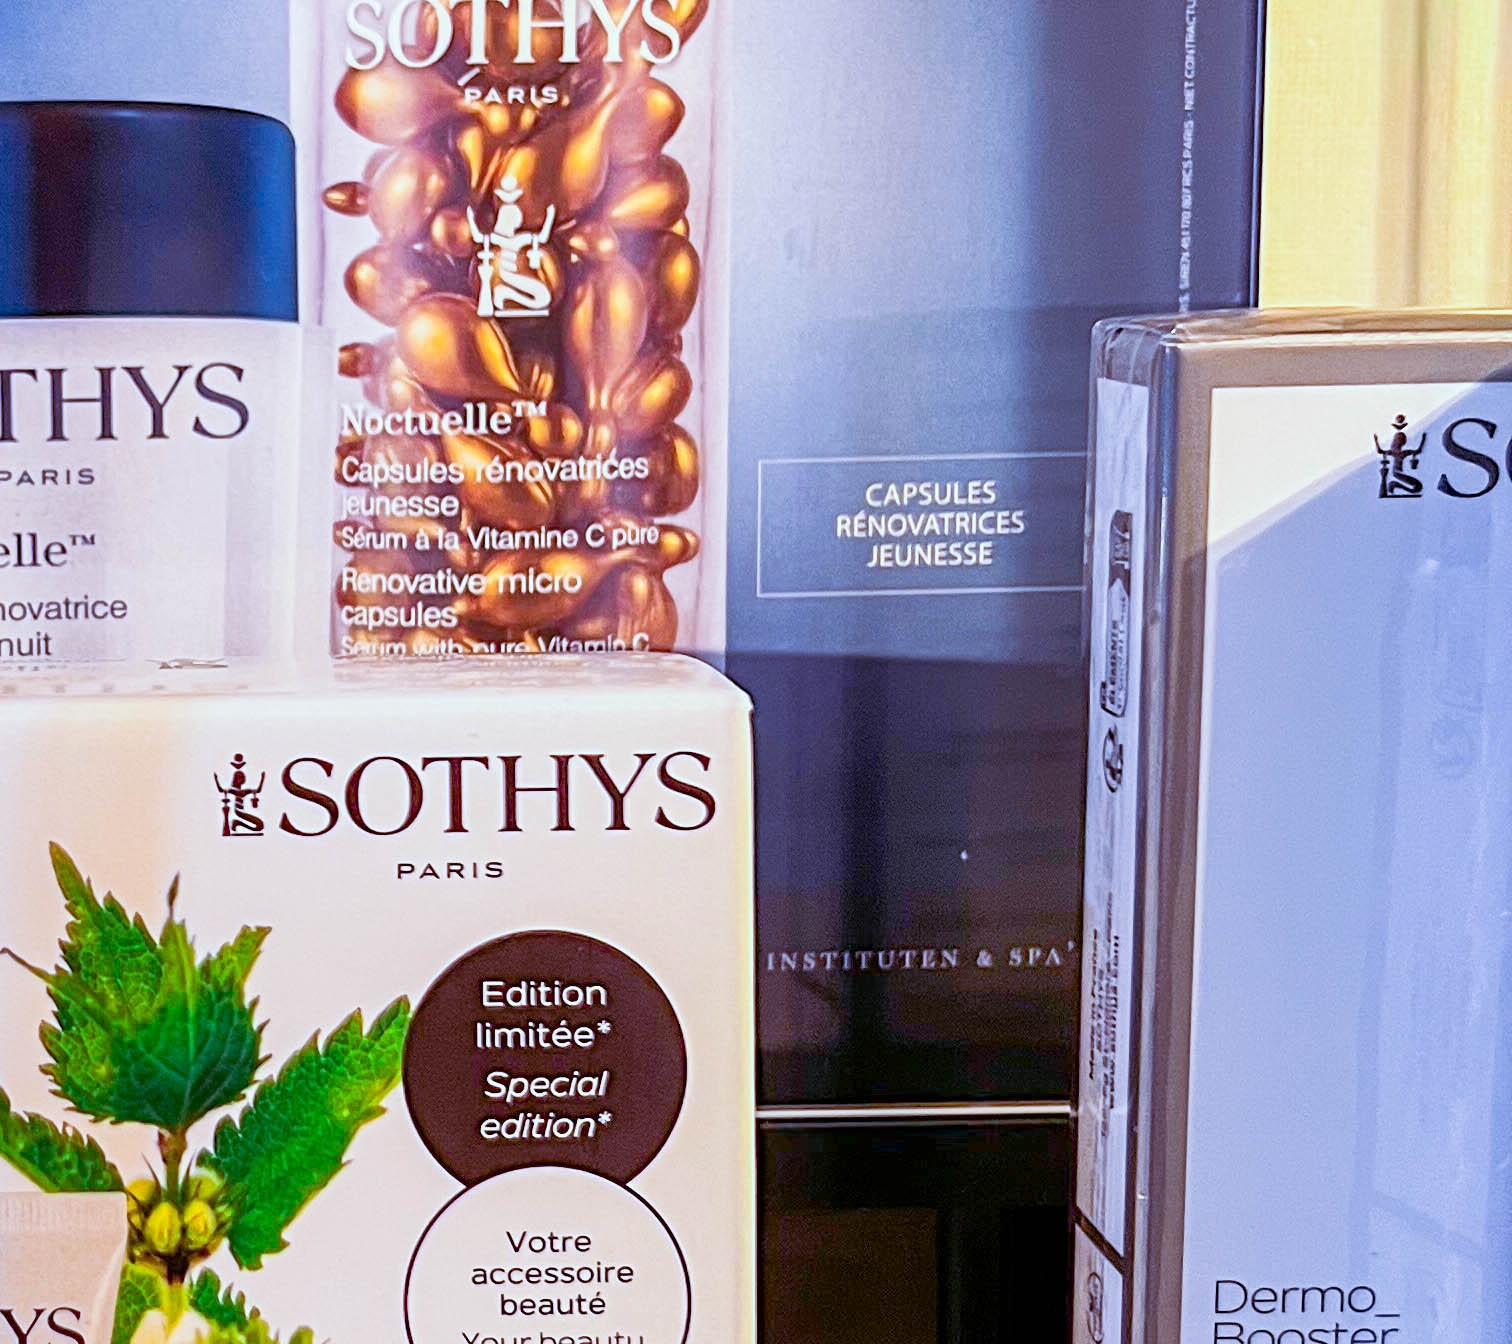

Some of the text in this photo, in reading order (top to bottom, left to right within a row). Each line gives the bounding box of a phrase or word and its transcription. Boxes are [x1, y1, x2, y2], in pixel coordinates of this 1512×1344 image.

[464, 87, 560, 105] PARIS
[1183, 81, 1195, 110] NIET
[1183, 120, 1194, 158] PARIS
[342, 449, 648, 486] Capsules rénovatrices
[866, 479, 996, 507] CAPSULES
[342, 495, 459, 519] jeunesse
[836, 507, 1024, 539] RÉNOVATRICES
[341, 524, 658, 550] Sérum à la Vitamine C pure
[866, 542, 993, 568] JEUNESSE
[341, 568, 582, 595] Renovative micro
[341, 601, 458, 629] capsules
[278, 751, 716, 837] SOTHYS
[397, 861, 503, 879] PARIS
[767, 949, 958, 971] INSTITUTEN
[976, 951, 992, 967] &
[482, 980, 608, 1010] Edition
[484, 1069, 609, 1103] Special
[506, 1231, 593, 1254] Votre
[471, 1262, 634, 1286] accessoire
[500, 1292, 606, 1317] beauté
[1214, 1280, 1400, 1317] Dermo_
